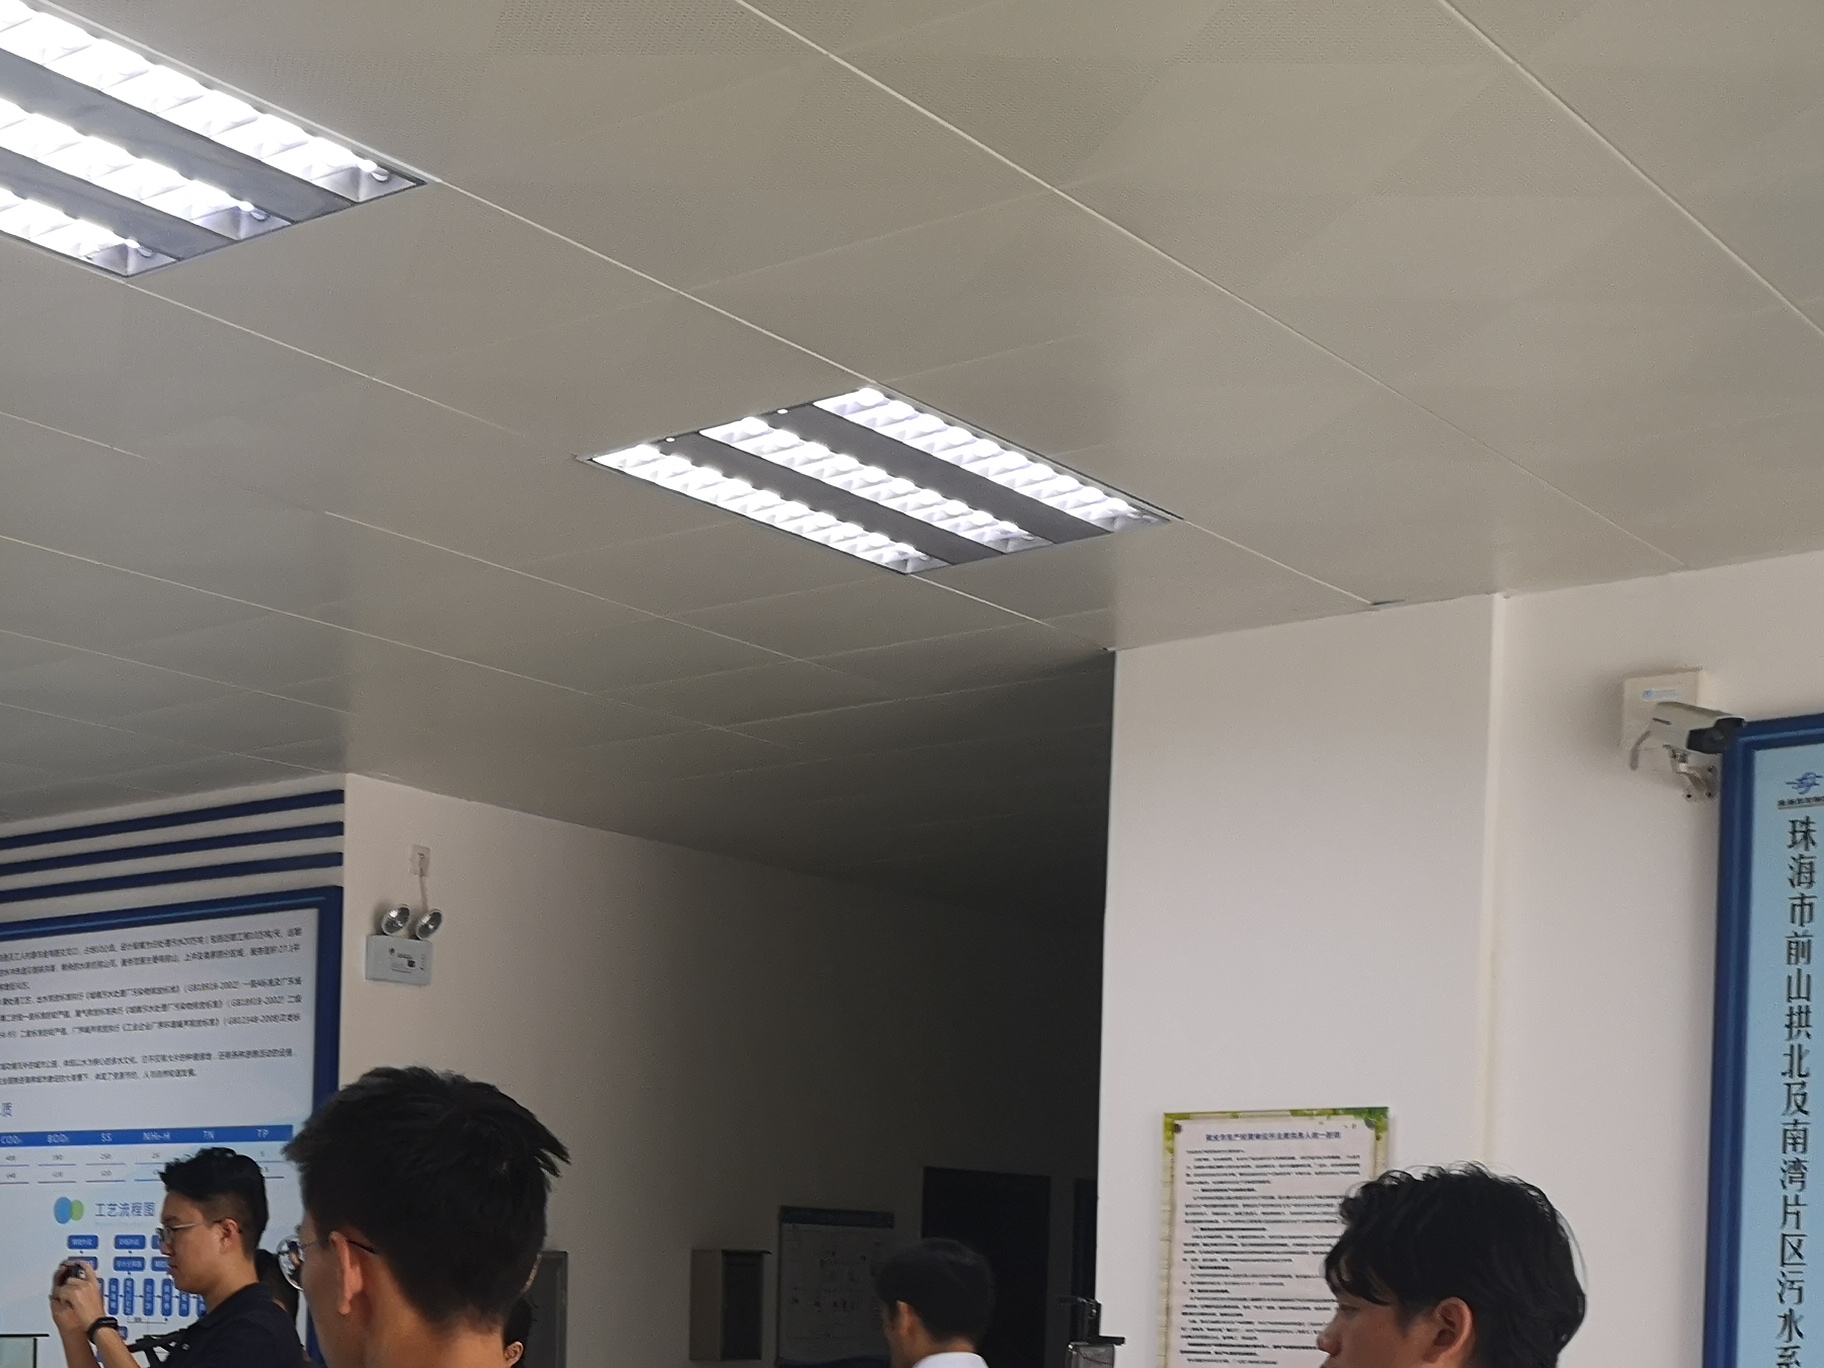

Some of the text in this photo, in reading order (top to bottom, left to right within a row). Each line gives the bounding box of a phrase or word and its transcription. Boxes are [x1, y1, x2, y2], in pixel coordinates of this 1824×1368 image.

[95, 1201, 156, 1217] 工艺流程图
